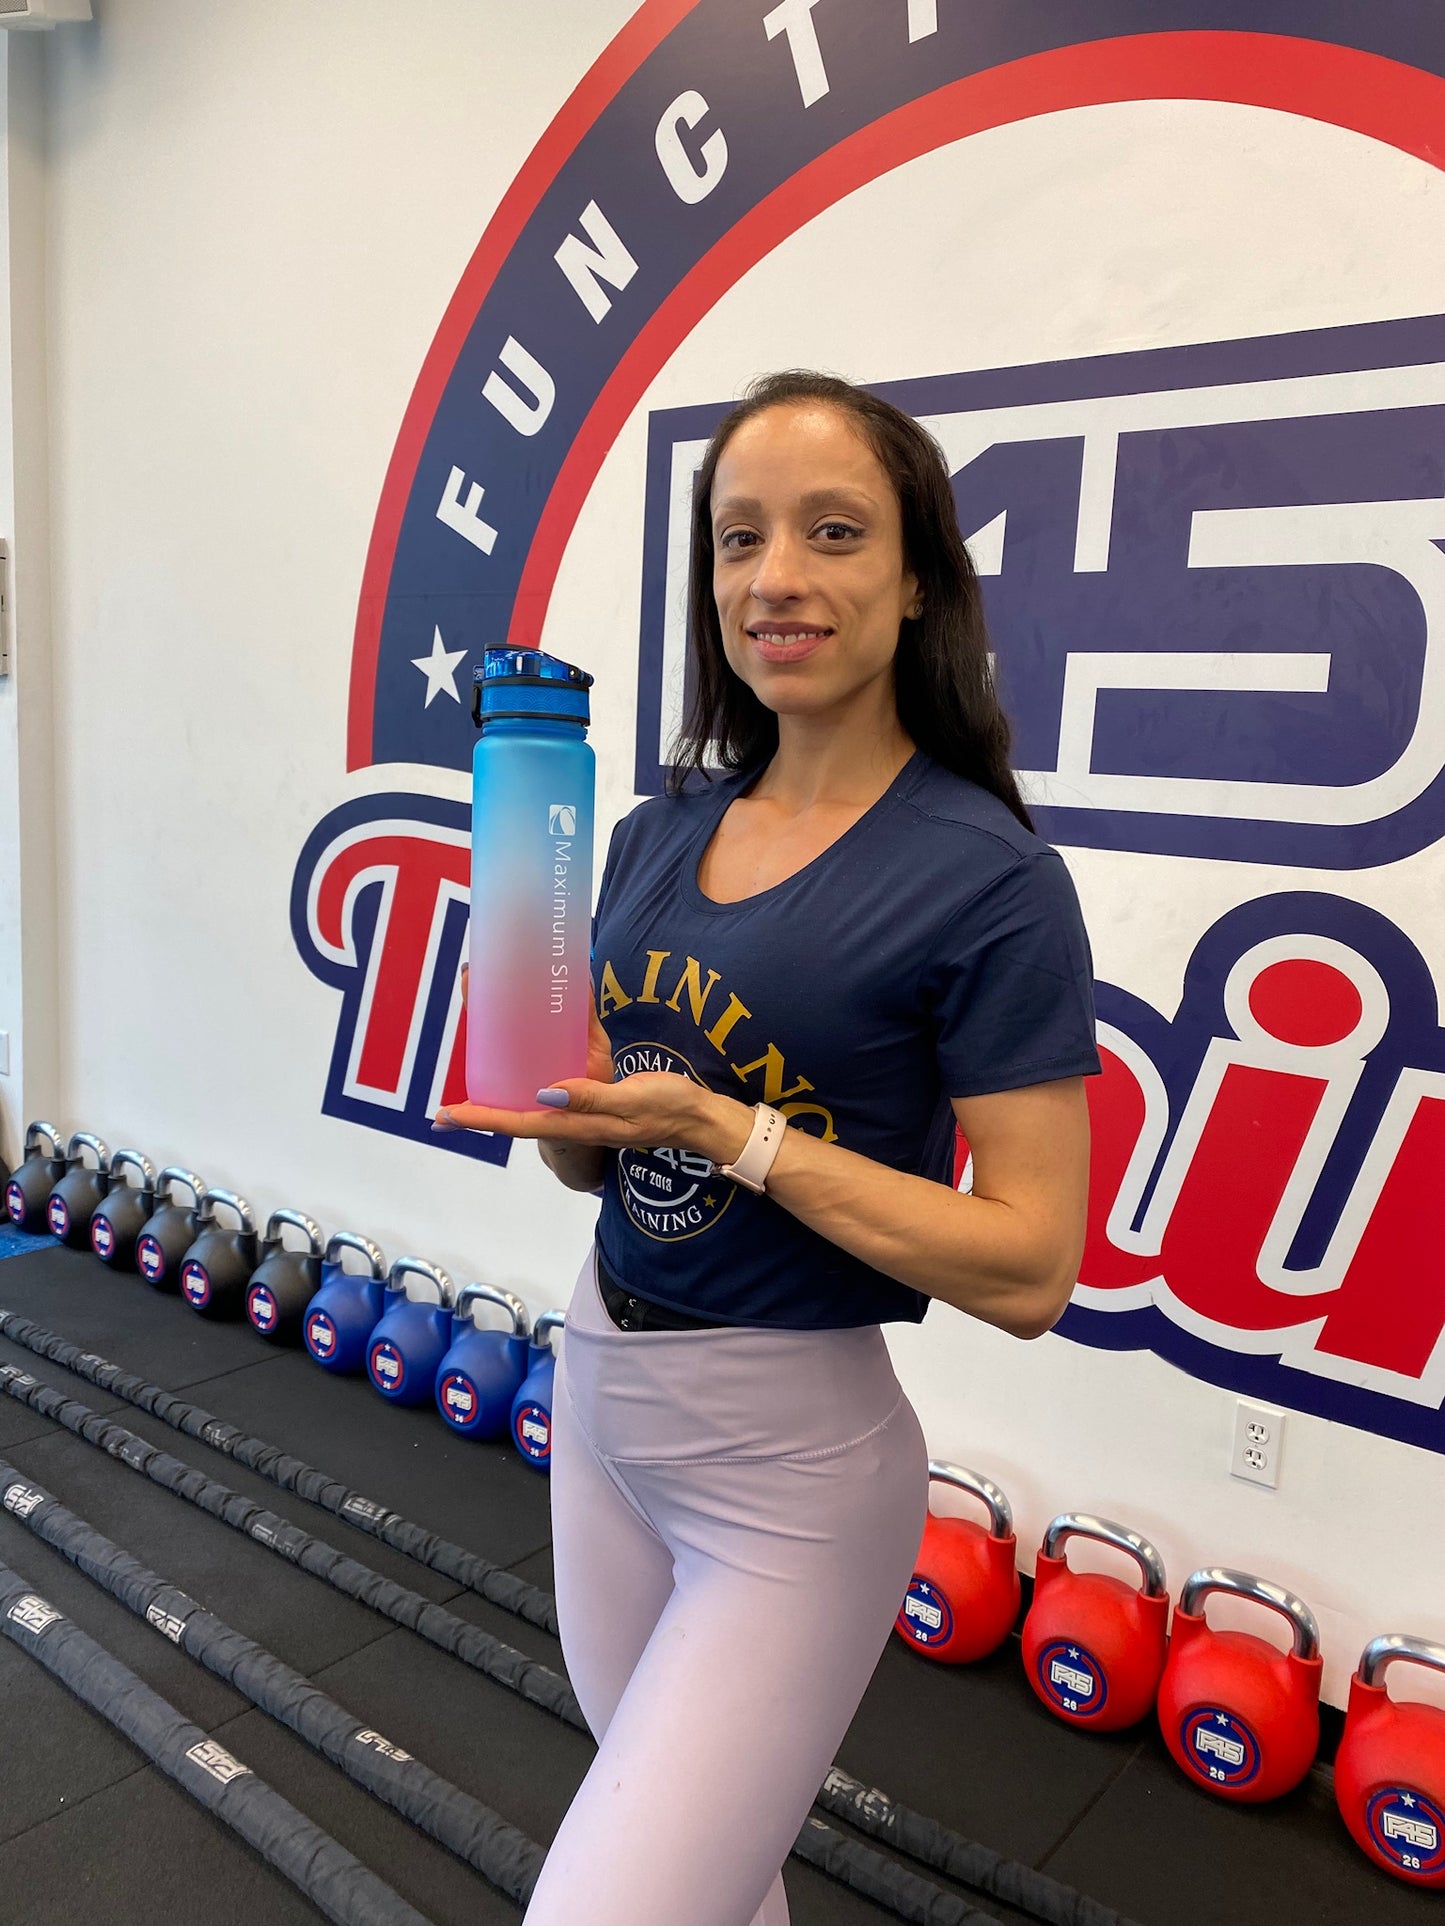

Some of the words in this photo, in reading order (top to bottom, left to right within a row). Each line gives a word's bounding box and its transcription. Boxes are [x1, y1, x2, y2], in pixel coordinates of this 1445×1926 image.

[672, 385, 1445, 805] 45
[551, 841, 572, 957] Maximum
[549, 964, 568, 1014] Slim
[629, 1163, 649, 1182] EST
[649, 1171, 673, 1193] 2013
[632, 1146, 714, 1178] 45
[905, 1595, 942, 1629] F45
[915, 1629, 928, 1642] 26
[1051, 1660, 1094, 1697] F45
[1063, 1697, 1077, 1712] 26
[1196, 1727, 1245, 1766] F45
[1208, 1766, 1226, 1782] 26
[1383, 1811, 1437, 1850] F45
[1402, 1853, 1421, 1870] 26
